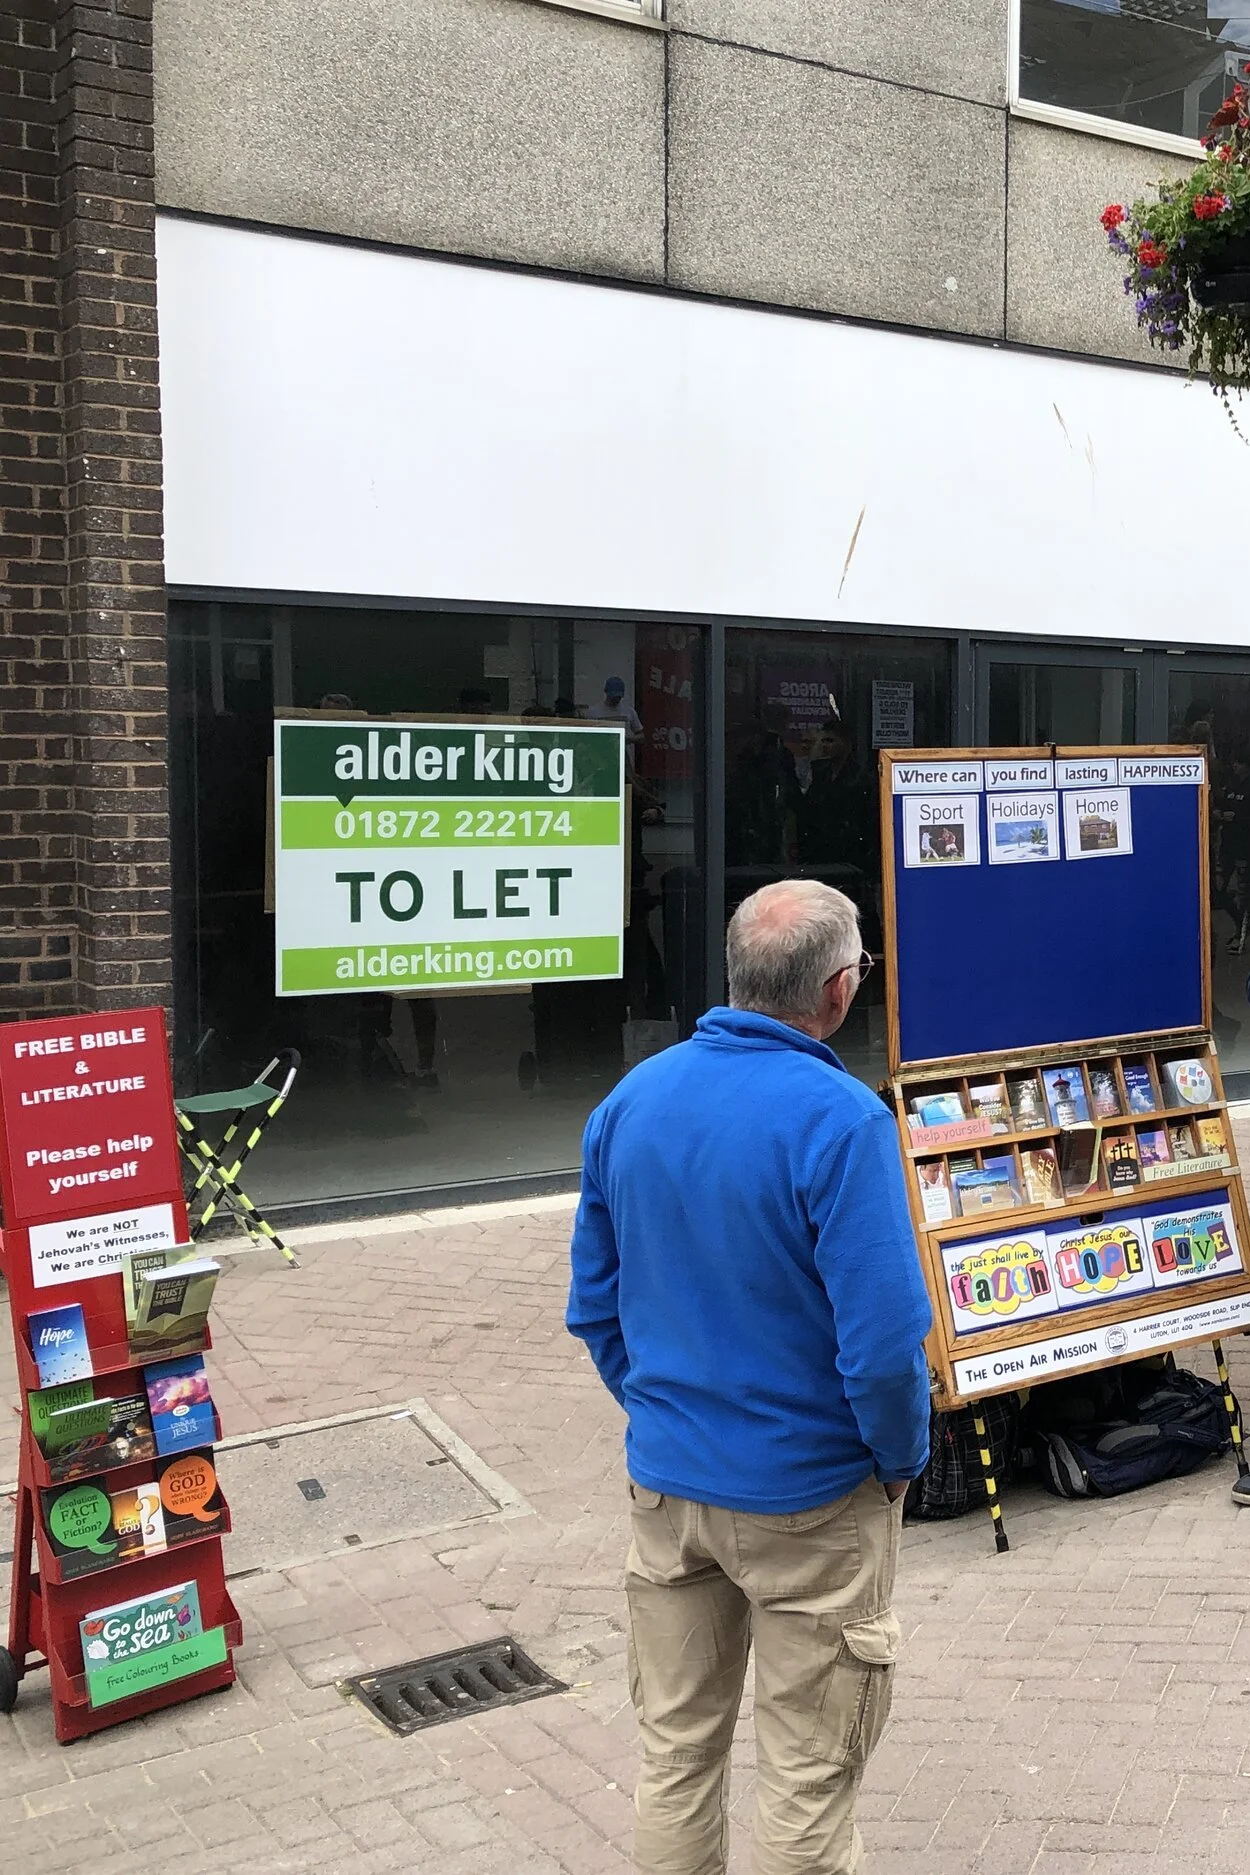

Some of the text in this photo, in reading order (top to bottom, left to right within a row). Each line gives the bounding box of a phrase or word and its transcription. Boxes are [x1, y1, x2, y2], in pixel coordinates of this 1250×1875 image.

[334, 731, 575, 794] alder king
[899, 764, 1200, 786] Where can you find lasting HAPPINESS?
[919, 803, 964, 824] Sport
[991, 800, 1055, 819] Holidays
[1076, 798, 1119, 815] Home
[334, 809, 573, 840] 01872 222174
[335, 867, 573, 923] TO LET
[335, 944, 574, 980] alderking.com
[14, 1027, 146, 1058] FREE BIBLE
[74, 1060, 90, 1075] &
[21, 1075, 146, 1106] LITERATURE
[916, 1119, 987, 1143] help yourself
[26, 1134, 153, 1167] Please help
[48, 1161, 139, 1195] yourself
[1153, 1158, 1223, 1179] Free Literature
[1172, 1210, 1223, 1227] demonstrates
[66, 1219, 139, 1239] We are NOT
[1183, 1227, 1196, 1237] His
[37, 1240, 101, 1260] Jehovah's
[103, 1229, 170, 1248] Witnesses,
[1059, 1230, 1132, 1249] Christ Jesus, our
[1155, 1229, 1230, 1268] LOVE
[51, 1258, 95, 1273] We are
[133, 1258, 149, 1270] YOU
[149, 1256, 164, 1267] CAN
[950, 1247, 1044, 1275] the just shall live by
[1058, 1241, 1142, 1283] HOPE
[1176, 1262, 1207, 1277] towards
[155, 1286, 184, 1300] TRUST
[156, 1280, 187, 1290] YOU CAN
[956, 1266, 1049, 1304] faith
[1138, 1322, 1161, 1334] HARRIER
[1183, 1310, 1211, 1323] WOODSIDE
[1230, 1303, 1240, 1312] SLIP
[1181, 1323, 1193, 1332] 4DQ
[40, 1328, 75, 1348] Hope
[965, 1341, 1098, 1383] THE OPEN AIR MISSION
[45, 1386, 89, 1406] ULTIMATE
[65, 1405, 107, 1423] ULTIMATE
[56, 1415, 106, 1434] QUESTIONS
[173, 1425, 198, 1439] JESUS
[169, 1469, 195, 1480] Where
[170, 1474, 205, 1492] GOD
[59, 1495, 98, 1509] Evolution
[171, 1491, 207, 1506] WRONG?
[61, 1501, 99, 1522] FACT
[63, 1520, 102, 1540] Fiction?
[76, 1518, 87, 1526] or
[118, 1523, 141, 1536] GOD
[102, 1608, 176, 1641] Go down
[115, 1640, 127, 1649] to
[130, 1624, 170, 1653] sea
[113, 1647, 129, 1659] the
[125, 1661, 169, 1682] Colouring
[171, 1649, 200, 1666] Books
